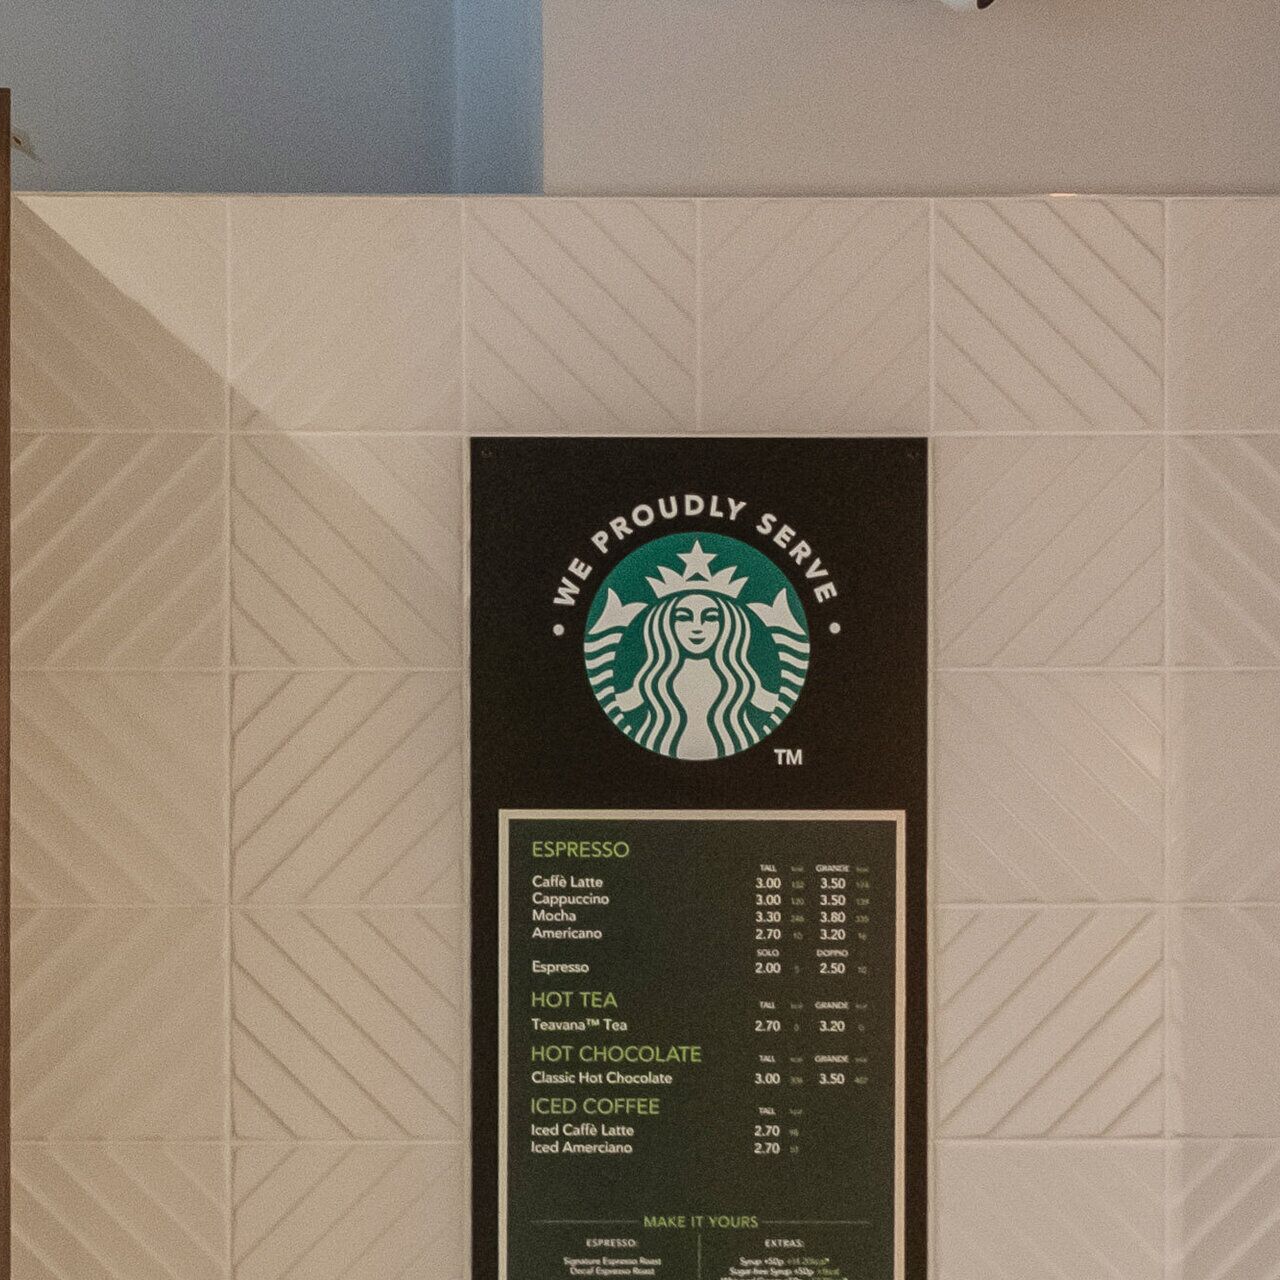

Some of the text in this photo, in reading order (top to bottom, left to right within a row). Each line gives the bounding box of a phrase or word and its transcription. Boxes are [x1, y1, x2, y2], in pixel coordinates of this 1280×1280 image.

[552, 493, 838, 608] WE PROUDLY SERVE
[531, 840, 630, 859] ESPRESSO
[569, 875, 604, 889] Latte
[755, 877, 782, 889] 3.00
[820, 877, 846, 889] 3.50
[532, 892, 610, 908] Cappuccino
[755, 894, 782, 906] 3.00
[820, 894, 846, 906] 3.50
[532, 909, 577, 923] Mocha
[755, 911, 782, 923] 3.30
[820, 911, 846, 923] 3.80
[532, 926, 846, 941] Americano 2.70 3.20
[532, 960, 846, 976] Espresso 2.00 2.50
[530, 991, 574, 1009] HOT
[579, 991, 618, 1009] TEA
[603, 1018, 628, 1033] Tea
[754, 1019, 782, 1032] 2.70
[819, 1019, 846, 1032] 3.20
[530, 1046, 574, 1063] HOT
[579, 1046, 702, 1064] CHOCOLATE
[531, 1070, 576, 1085] Classic
[578, 1071, 603, 1085] Hot
[605, 1070, 673, 1085] Chocolate
[754, 1072, 782, 1085] 3.00
[819, 1072, 846, 1085] 3.50
[530, 1097, 577, 1115] ICED
[582, 1097, 661, 1115] COFFEE
[530, 1122, 781, 1137] Iced Caffè Latte 2.70
[530, 1140, 560, 1154] Iced
[754, 1142, 781, 1154] 2.70
[643, 1215, 759, 1229] MAKE IT YOURS
